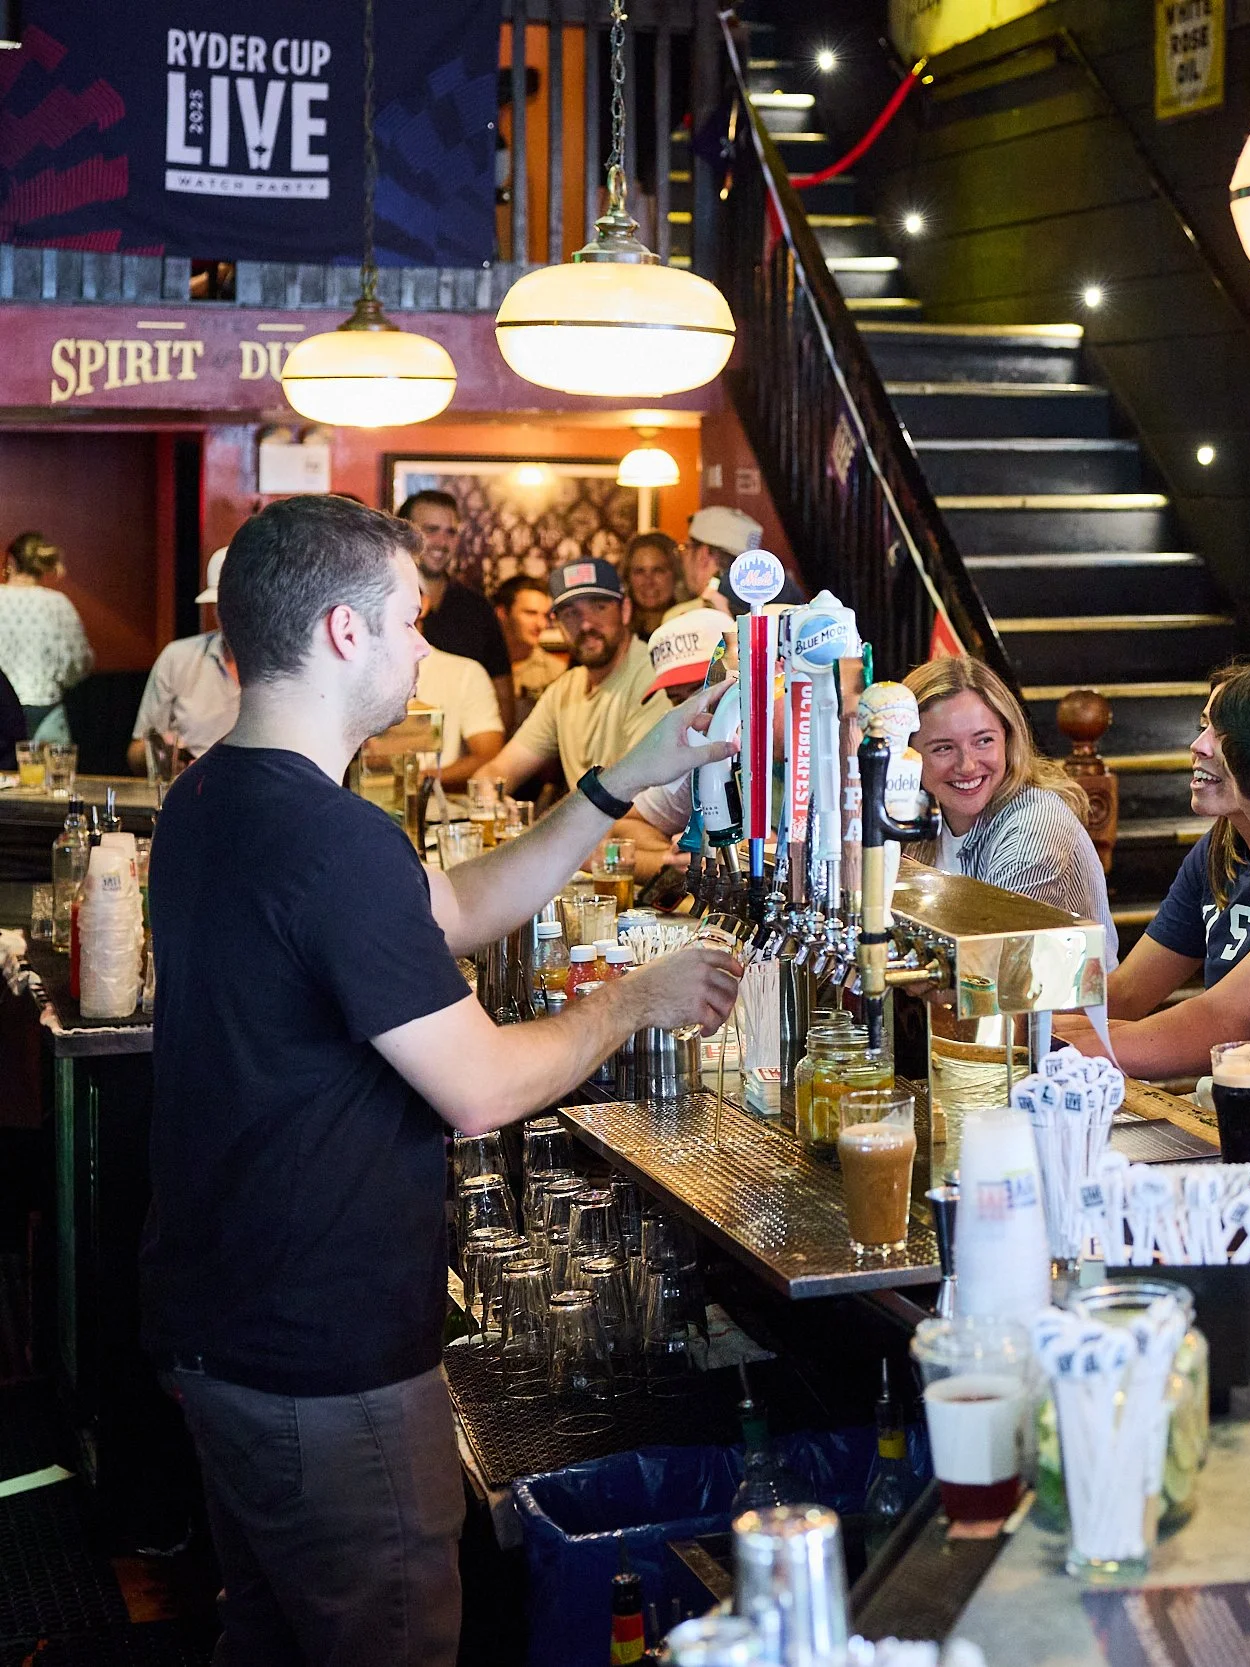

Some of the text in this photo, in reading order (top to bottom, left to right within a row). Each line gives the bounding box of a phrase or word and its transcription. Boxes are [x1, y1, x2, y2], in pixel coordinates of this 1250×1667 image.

[167, 28, 331, 76] RYDER CUP
[1170, 24, 1209, 54] ROSE
[166, 70, 329, 171] LIVE
[189, 88, 204, 135] 2025
[178, 176, 244, 190] WATCH
[51, 338, 300, 404] SPIRIT DU
[674, 632, 702, 653] CUP
[794, 637, 819, 656] BLUE
[885, 773, 919, 792] odelo
